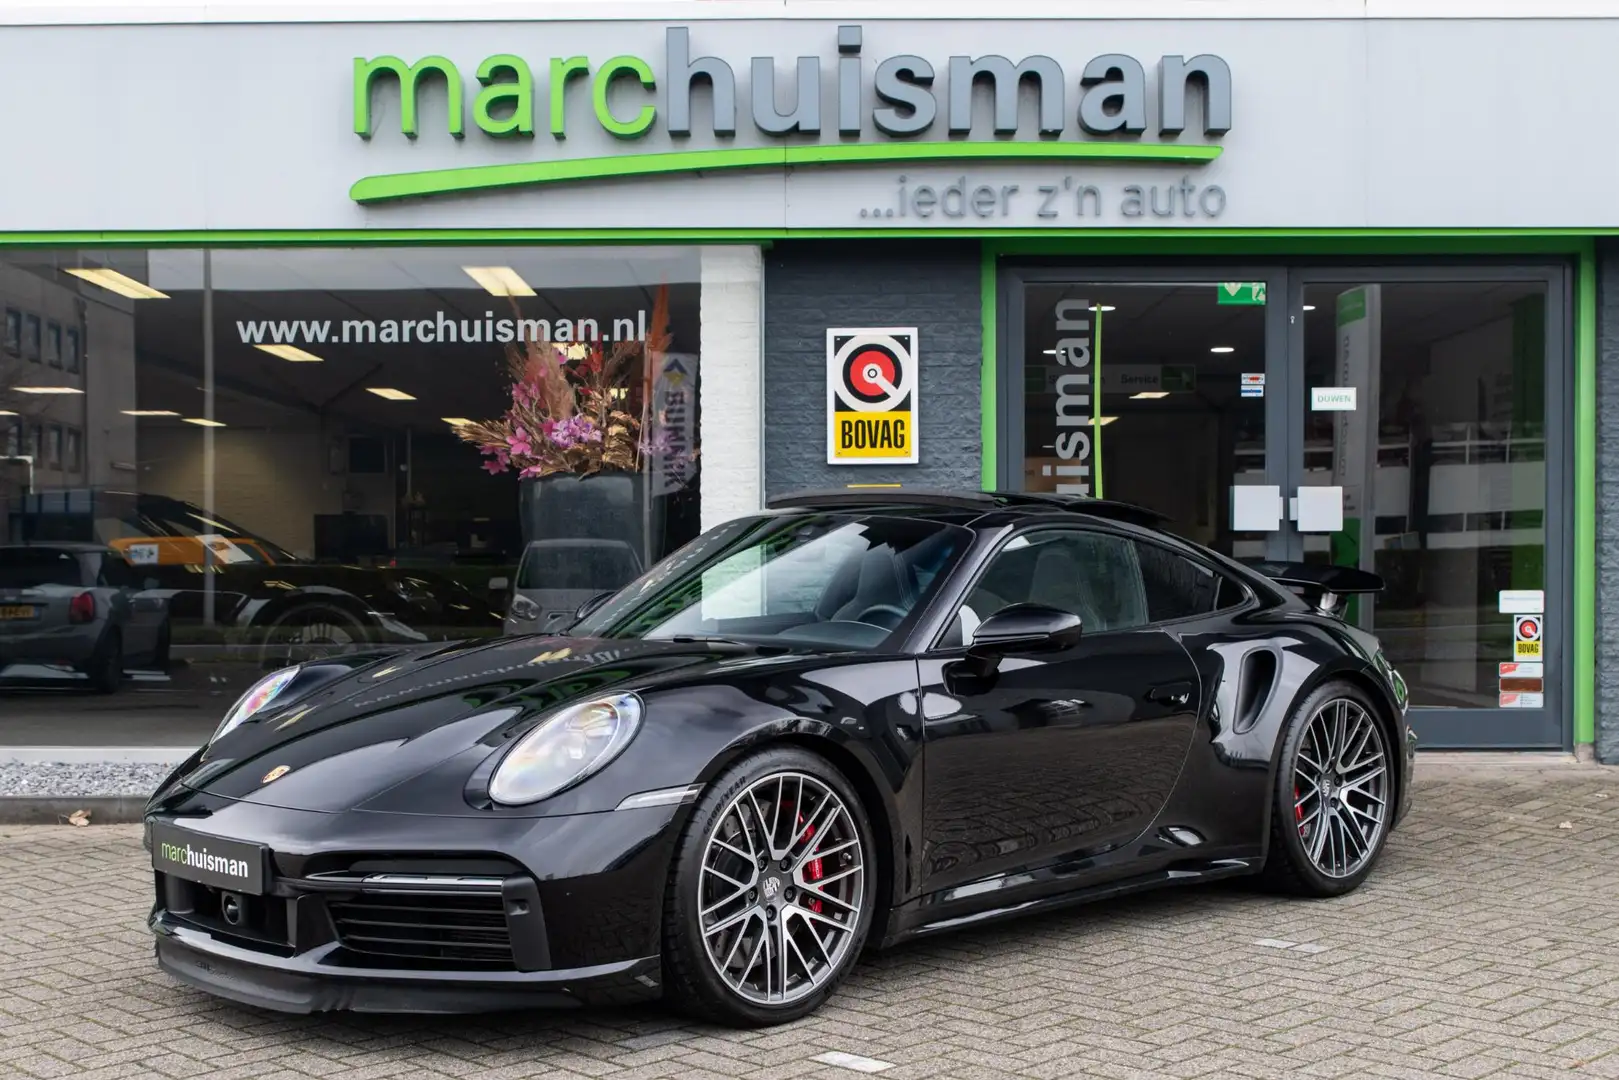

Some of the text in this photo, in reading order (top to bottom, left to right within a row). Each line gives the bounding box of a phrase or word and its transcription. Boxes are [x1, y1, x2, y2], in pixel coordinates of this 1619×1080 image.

[353, 25, 1232, 139] marchuisman
[1036, 176, 1101, 218] z'n
[1120, 176, 1227, 218] auto
[236, 310, 647, 344] www.marchuisman.nl
[1317, 394, 1351, 403] DUWEN
[841, 418, 905, 449] BOVAG
[1517, 643, 1539, 654] BOVAG
[161, 842, 249, 878] marchuisman
